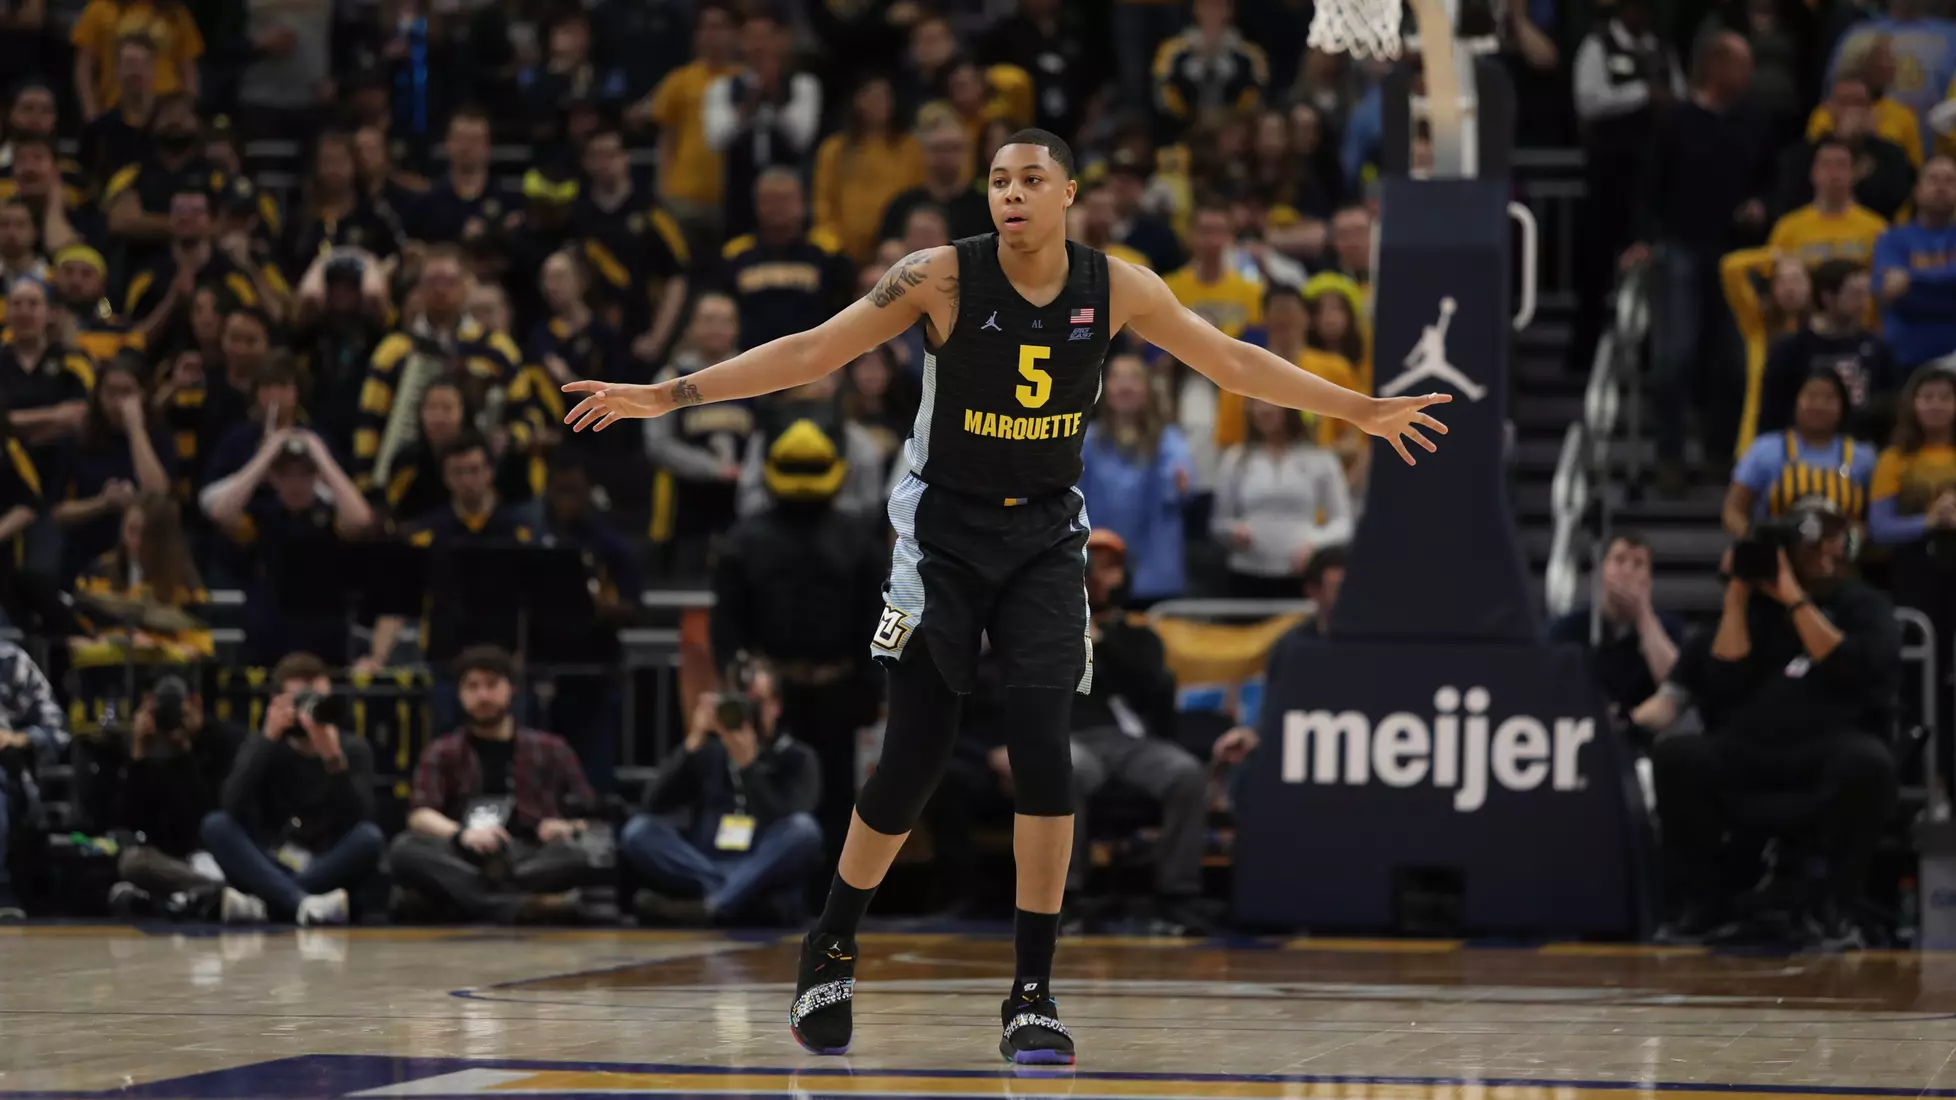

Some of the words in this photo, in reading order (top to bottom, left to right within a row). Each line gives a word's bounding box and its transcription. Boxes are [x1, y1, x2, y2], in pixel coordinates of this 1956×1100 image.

[1031, 319, 1043, 329] AL
[1015, 344, 1053, 409] 5
[964, 408, 1082, 440] MARQUETTE
[1281, 685, 1596, 812] meijer
